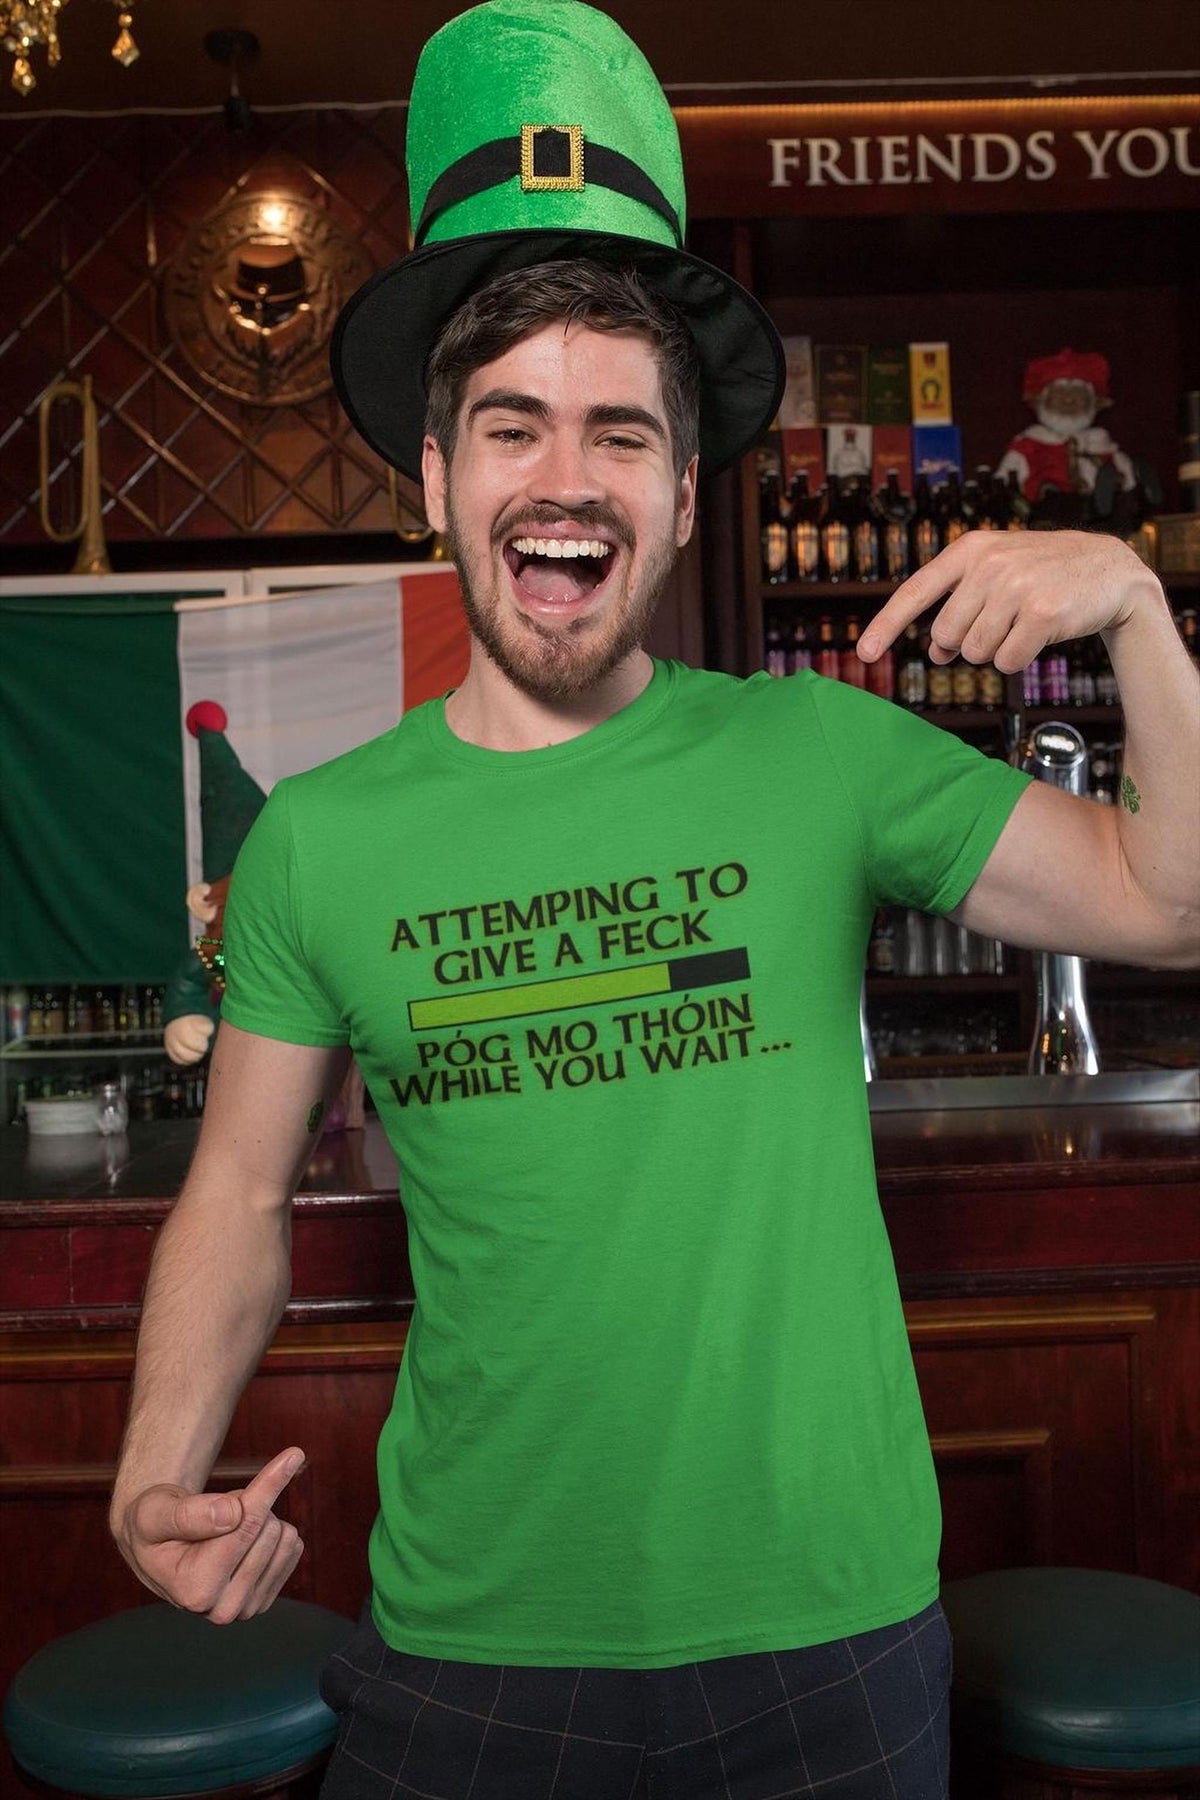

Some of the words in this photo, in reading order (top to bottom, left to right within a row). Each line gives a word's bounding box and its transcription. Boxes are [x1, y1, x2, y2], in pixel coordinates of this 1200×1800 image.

[767, 130, 1057, 187] FRIENDS
[391, 876, 659, 952] ATTEMPING
[675, 862, 748, 904] TO
[434, 938, 536, 985] GIVE
[555, 933, 583, 967] A
[599, 909, 712, 960] FECK
[416, 1031, 510, 1068] PÓG
[526, 1021, 597, 1059] MO
[613, 993, 752, 1044] THÓIN
[389, 1065, 521, 1107] WHILE
[535, 1050, 625, 1090] YOU
